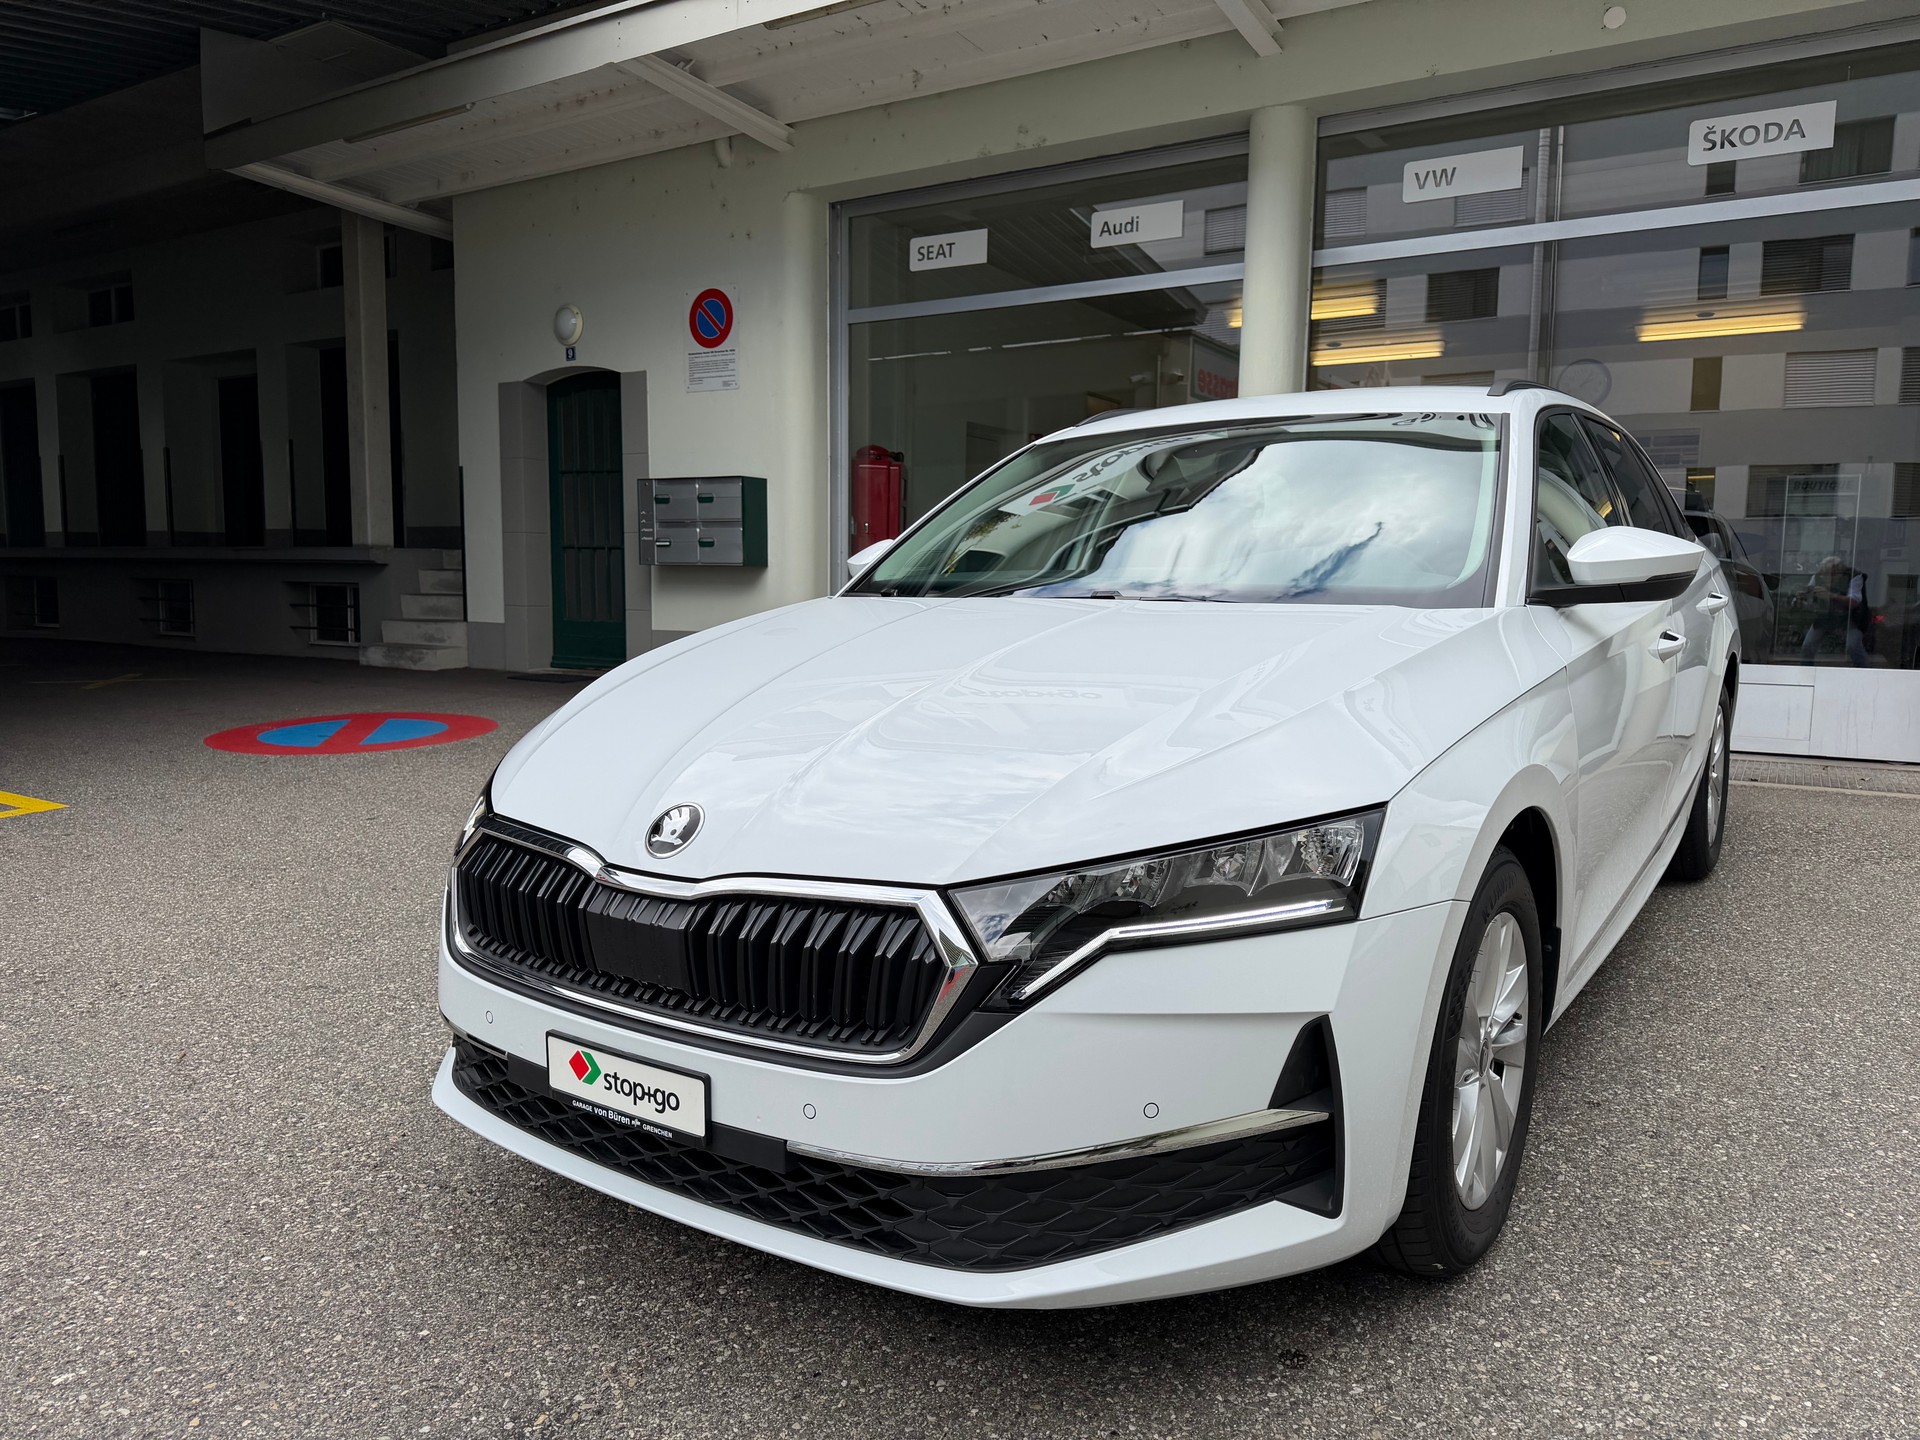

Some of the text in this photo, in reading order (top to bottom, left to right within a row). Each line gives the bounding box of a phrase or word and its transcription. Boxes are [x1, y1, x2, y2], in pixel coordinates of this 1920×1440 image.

[1702, 118, 1806, 152] ŠKODA
[1414, 166, 1457, 190] VW
[1099, 216, 1140, 237] Audi
[917, 242, 956, 261] SEAT
[567, 348, 573, 359] 9
[603, 1071, 680, 1114] stop+go
[572, 1100, 673, 1139] GARAGE von Büren GRENCHEN
